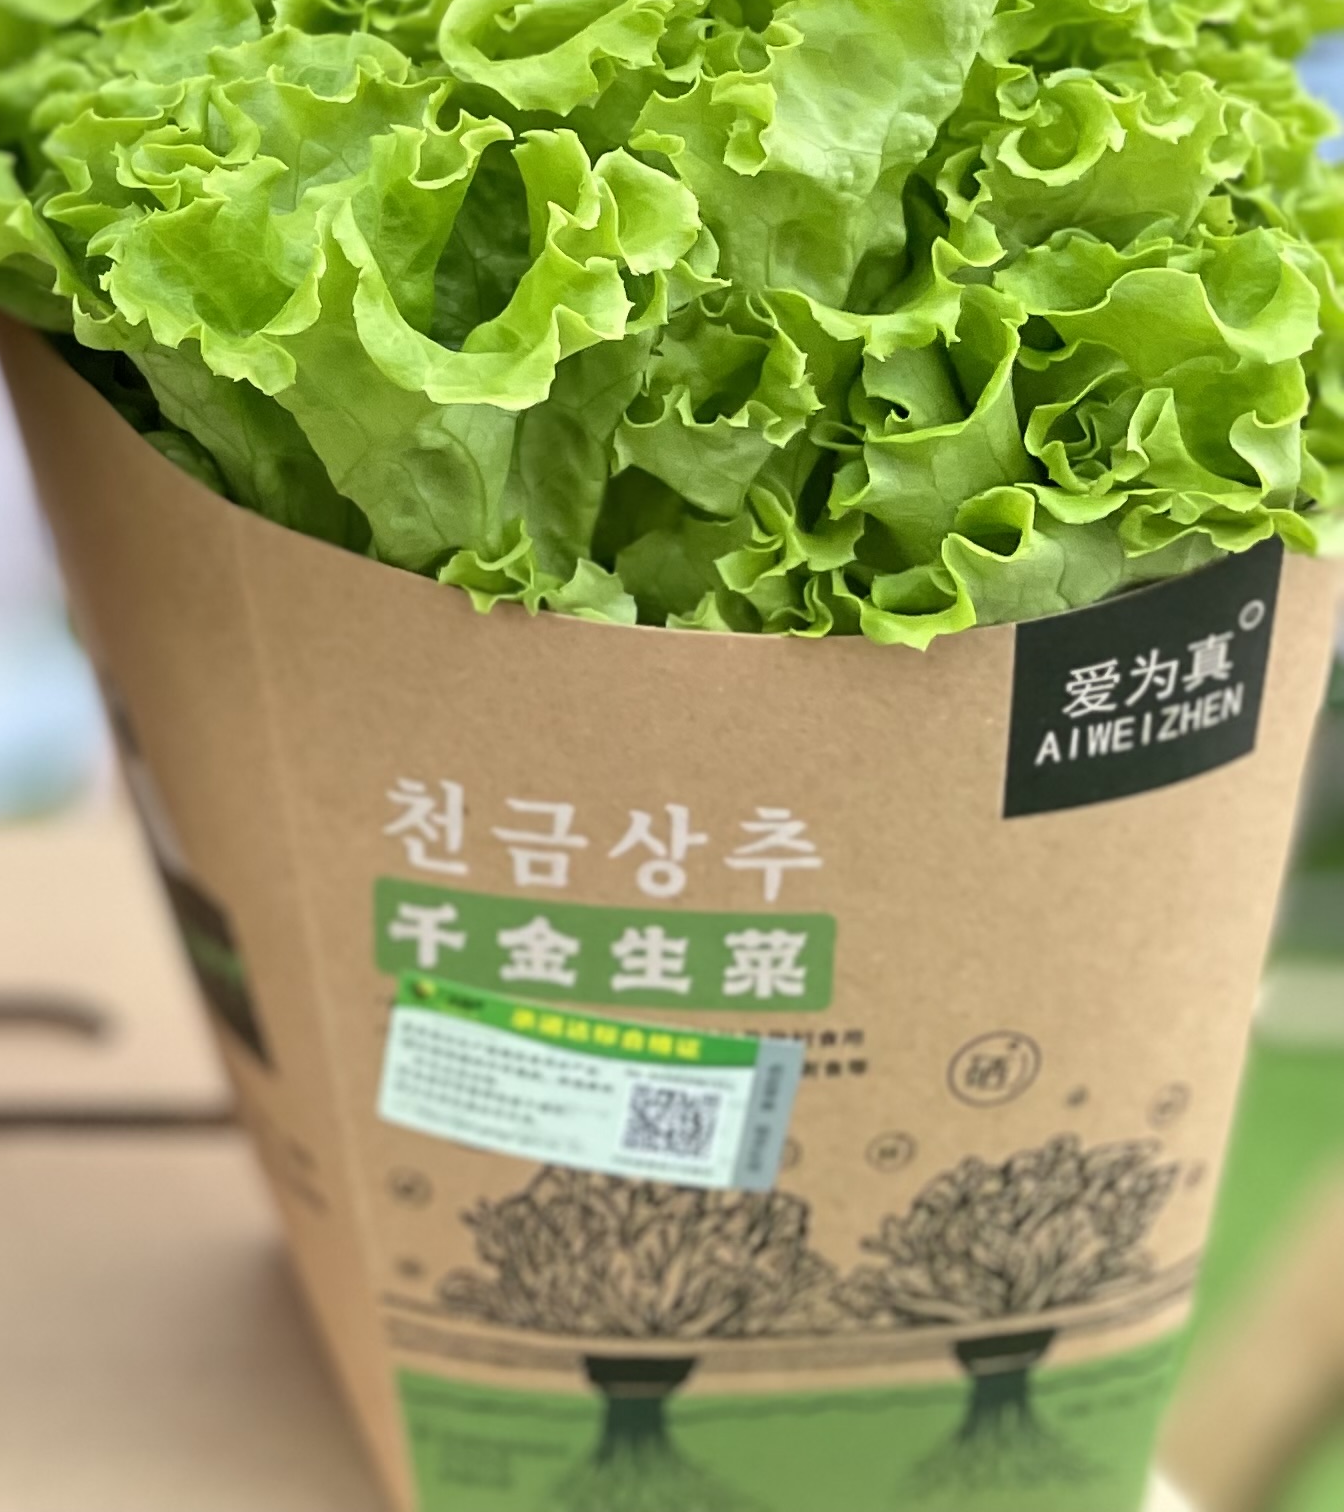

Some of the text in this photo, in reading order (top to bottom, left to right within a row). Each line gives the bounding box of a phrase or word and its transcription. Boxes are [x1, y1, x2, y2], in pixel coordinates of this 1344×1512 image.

[1063, 631, 1235, 719] 爱为真
[1035, 683, 1244, 766] AIWEIZHEN
[382, 778, 823, 901] 천금상추
[388, 903, 810, 1000] 千金生菜
